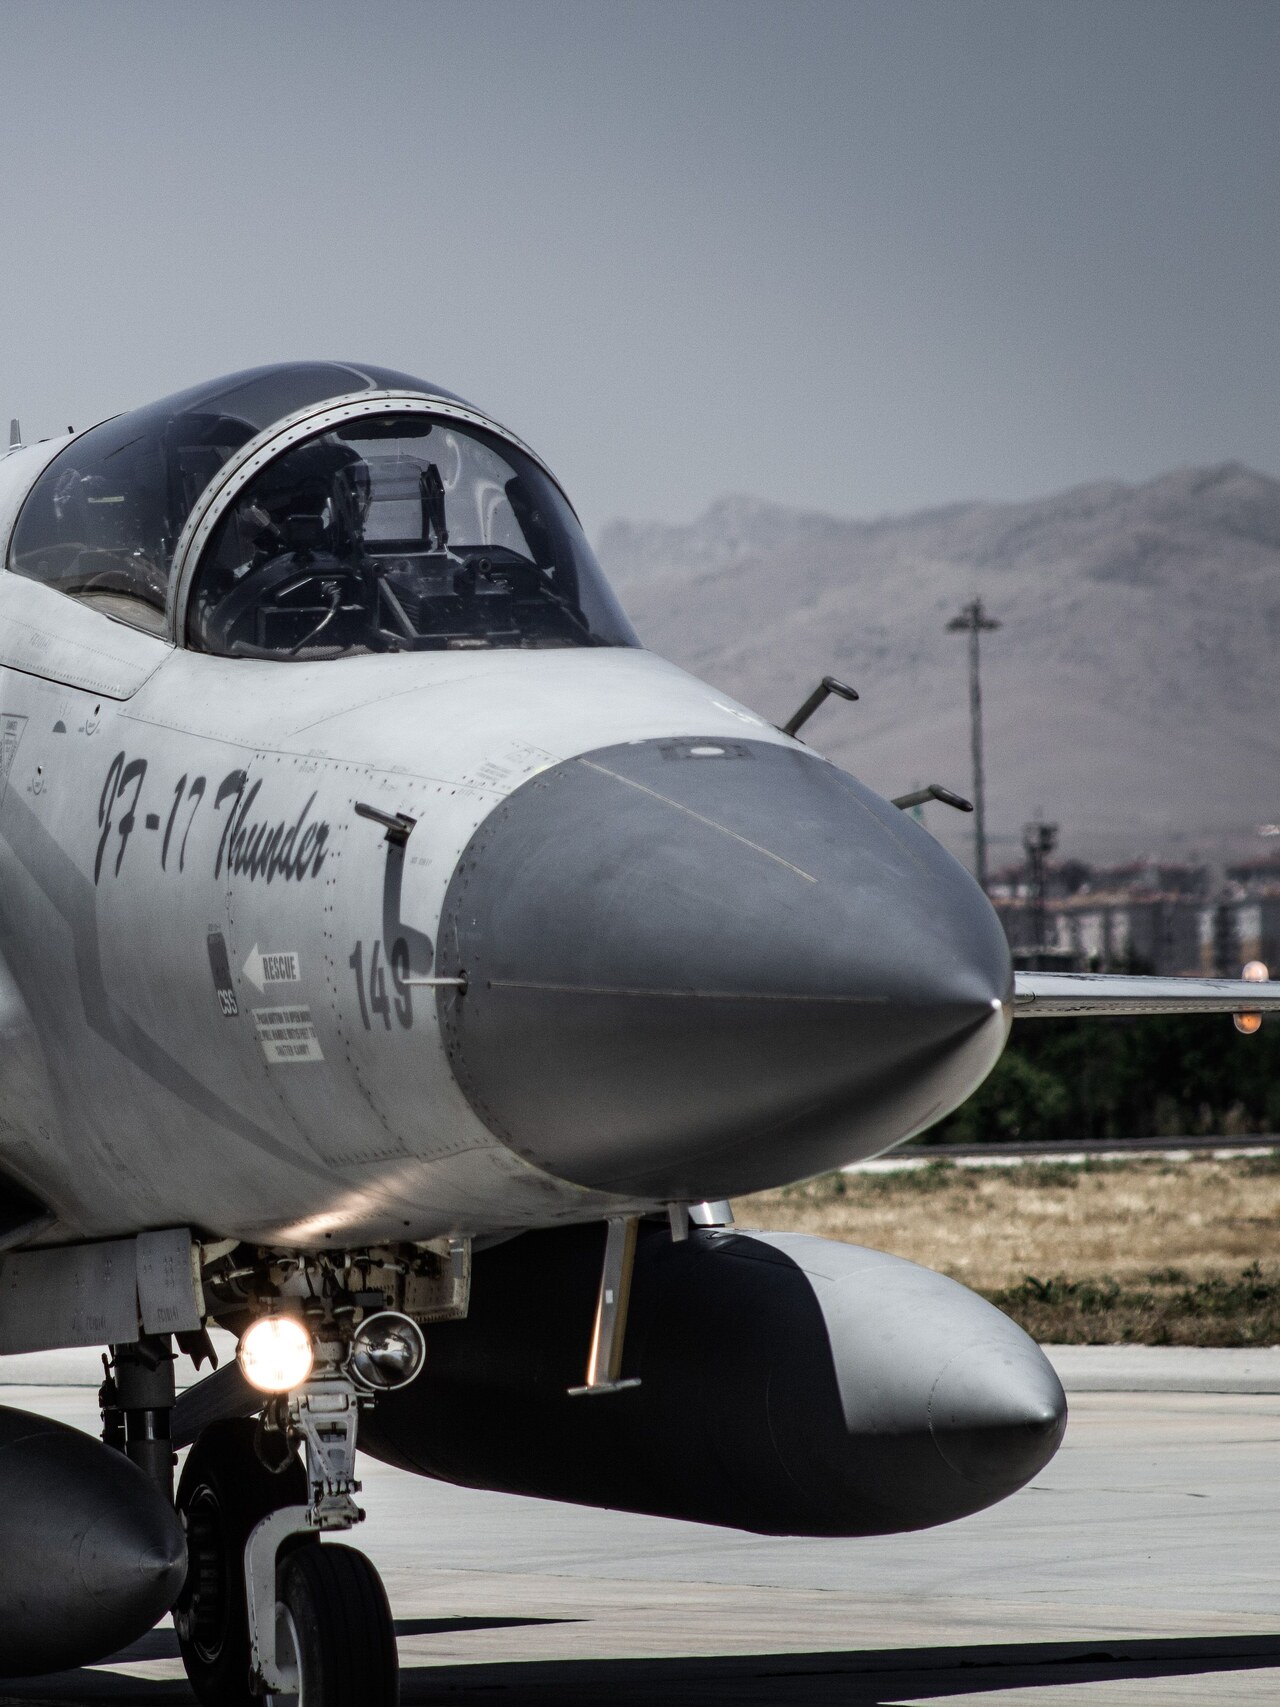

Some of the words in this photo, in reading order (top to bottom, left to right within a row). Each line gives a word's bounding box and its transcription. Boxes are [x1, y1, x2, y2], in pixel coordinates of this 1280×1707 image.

[213, 768, 330, 885] Thunder
[262, 955, 297, 981] RESCUE
[349, 937, 413, 1031] 149
[217, 988, 238, 1015] CSS
